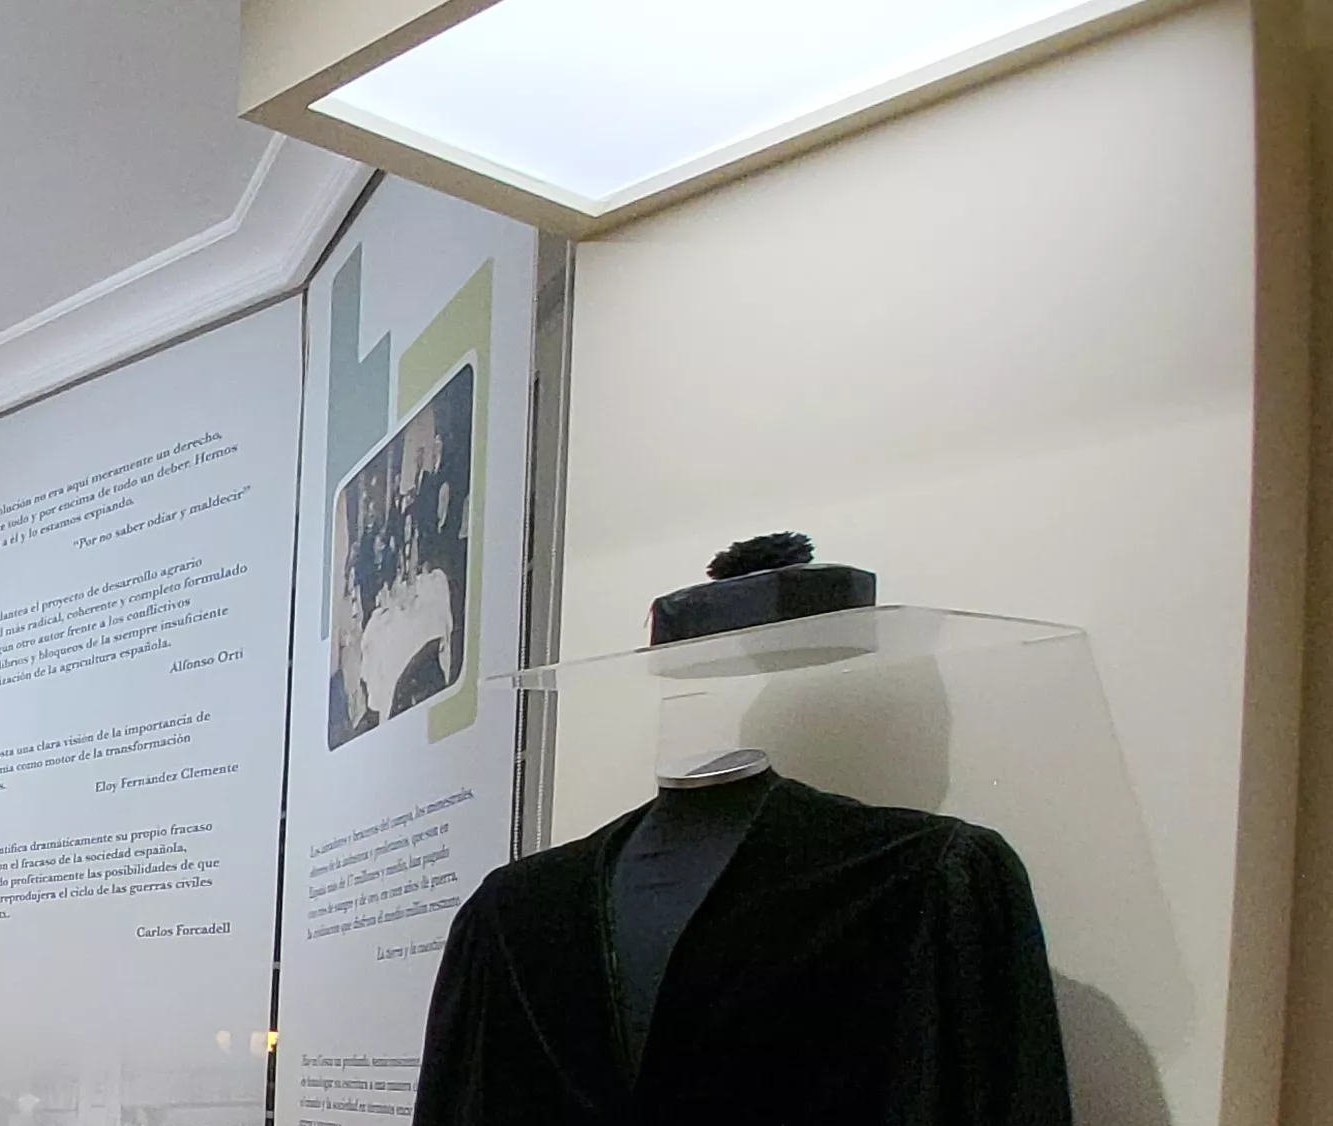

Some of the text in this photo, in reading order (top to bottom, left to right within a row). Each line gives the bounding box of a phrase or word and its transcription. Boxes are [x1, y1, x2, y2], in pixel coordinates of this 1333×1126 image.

[34, 494, 47, 504] no
[48, 488, 65, 498] era
[67, 477, 89, 493] aquí
[92, 456, 154, 484] meramente
[156, 450, 171, 461] un
[173, 433, 223, 454] derecho,
[99, 533, 113, 543] no
[115, 522, 146, 537] saber
[147, 511, 178, 527] odiar
[180, 509, 188, 521] y
[31, 601, 40, 613] el
[42, 593, 85, 613] proyecto
[87, 586, 100, 597] de
[102, 571, 158, 593] desarrollo
[160, 559, 203, 579] agrario
[170, 657, 215, 674] Alfonso
[96, 781, 119, 793] Eloy
[181, 765, 239, 779] Clemente
[115, 833, 128, 841] su
[131, 829, 168, 843] propio
[170, 824, 213, 835] fracaso
[137, 923, 231, 938] Carlos Forcadell
